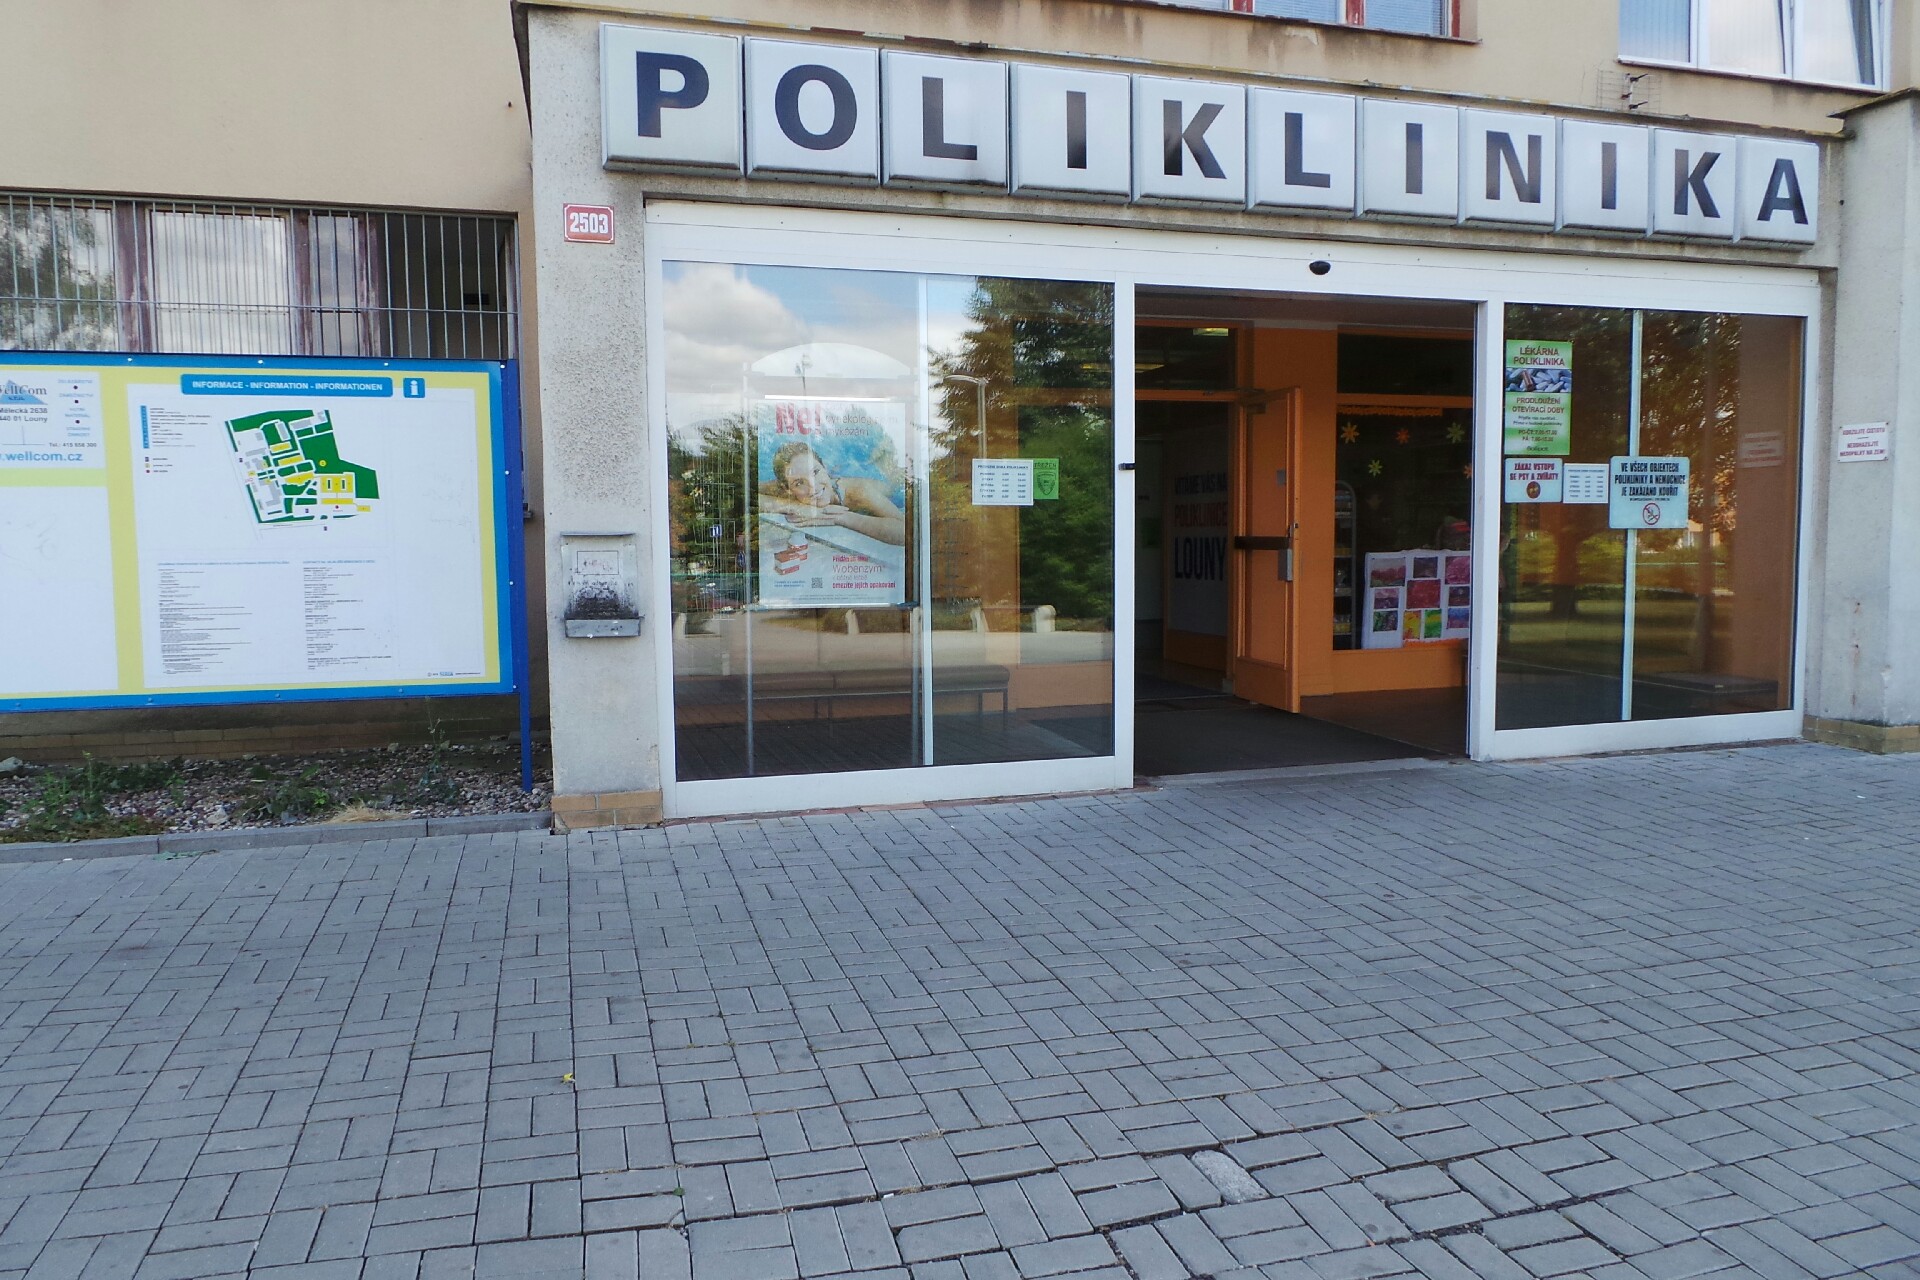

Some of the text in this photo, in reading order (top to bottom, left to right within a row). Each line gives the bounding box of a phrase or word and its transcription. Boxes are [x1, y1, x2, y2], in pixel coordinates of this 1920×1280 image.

[635, 51, 1809, 225] POLIKLINIKA
[569, 212, 609, 234] 2503
[1519, 345, 1559, 356] LÉKÁRNA
[1513, 356, 1565, 366] POLIKLINIKA
[192, 381, 244, 389] INFORMACE
[250, 382, 309, 390] INFORMATION
[315, 383, 383, 391] INFORMATIONEN
[1512, 405, 1546, 413] OTEVÍRACÍ
[24, 415, 47, 423] Louny
[0, 451, 83, 461] .wellcom.cz
[1514, 462, 1555, 471] ZÁKAZ VSTUPU
[1621, 460, 1680, 472] VE VŠECH OBJEKTECH
[1614, 474, 1686, 484] POLIKLINIKY A NEMOCNICE
[1621, 486, 1627, 496] JE
[1629, 485, 1657, 496] ZAKÁZÁNO
[1174, 536, 1227, 581] LOUNY
